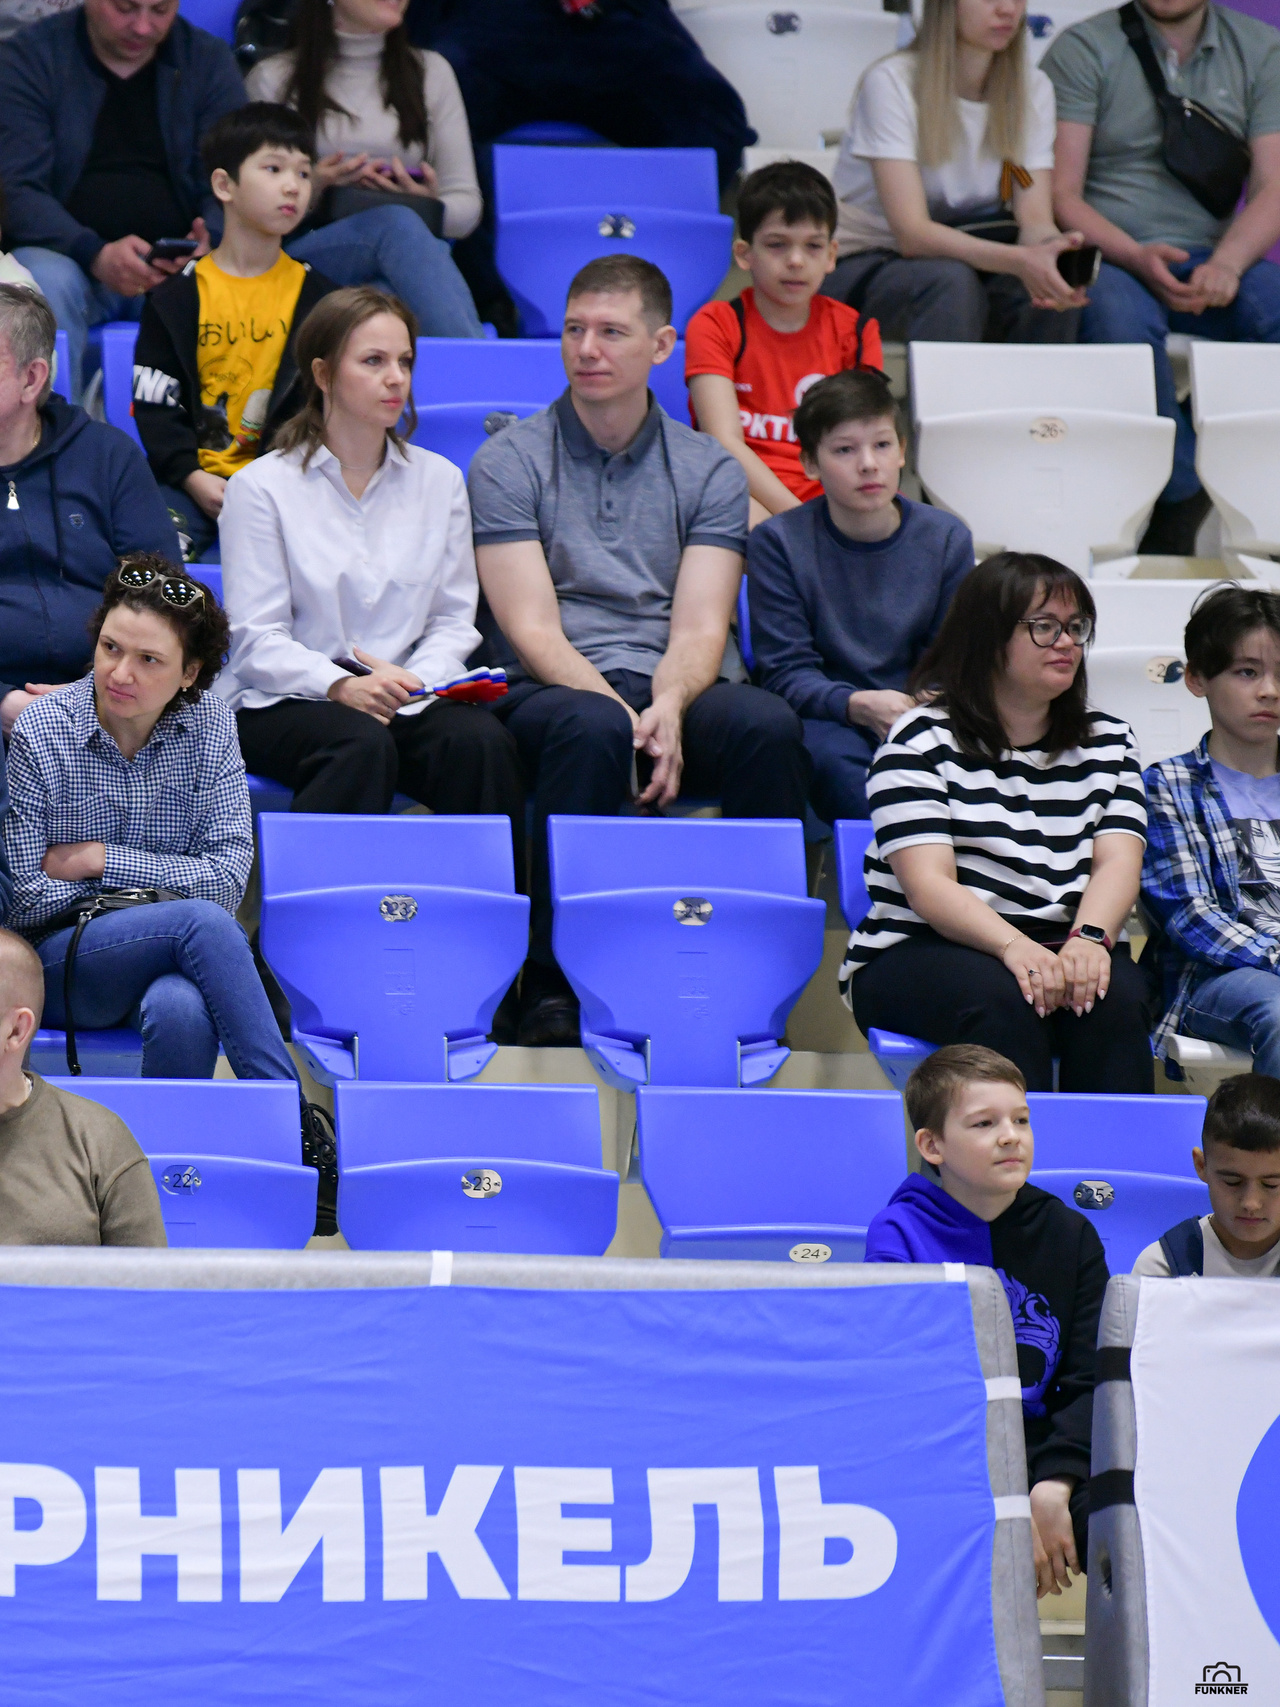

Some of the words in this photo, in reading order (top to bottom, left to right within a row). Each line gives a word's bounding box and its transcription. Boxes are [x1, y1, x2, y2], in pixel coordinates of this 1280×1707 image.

[389, 901, 408, 916] 23
[172, 1173, 192, 1188] 22
[472, 1176, 491, 1191] 23
[1086, 1187, 1104, 1203] 25
[800, 1248, 820, 1259] 24
